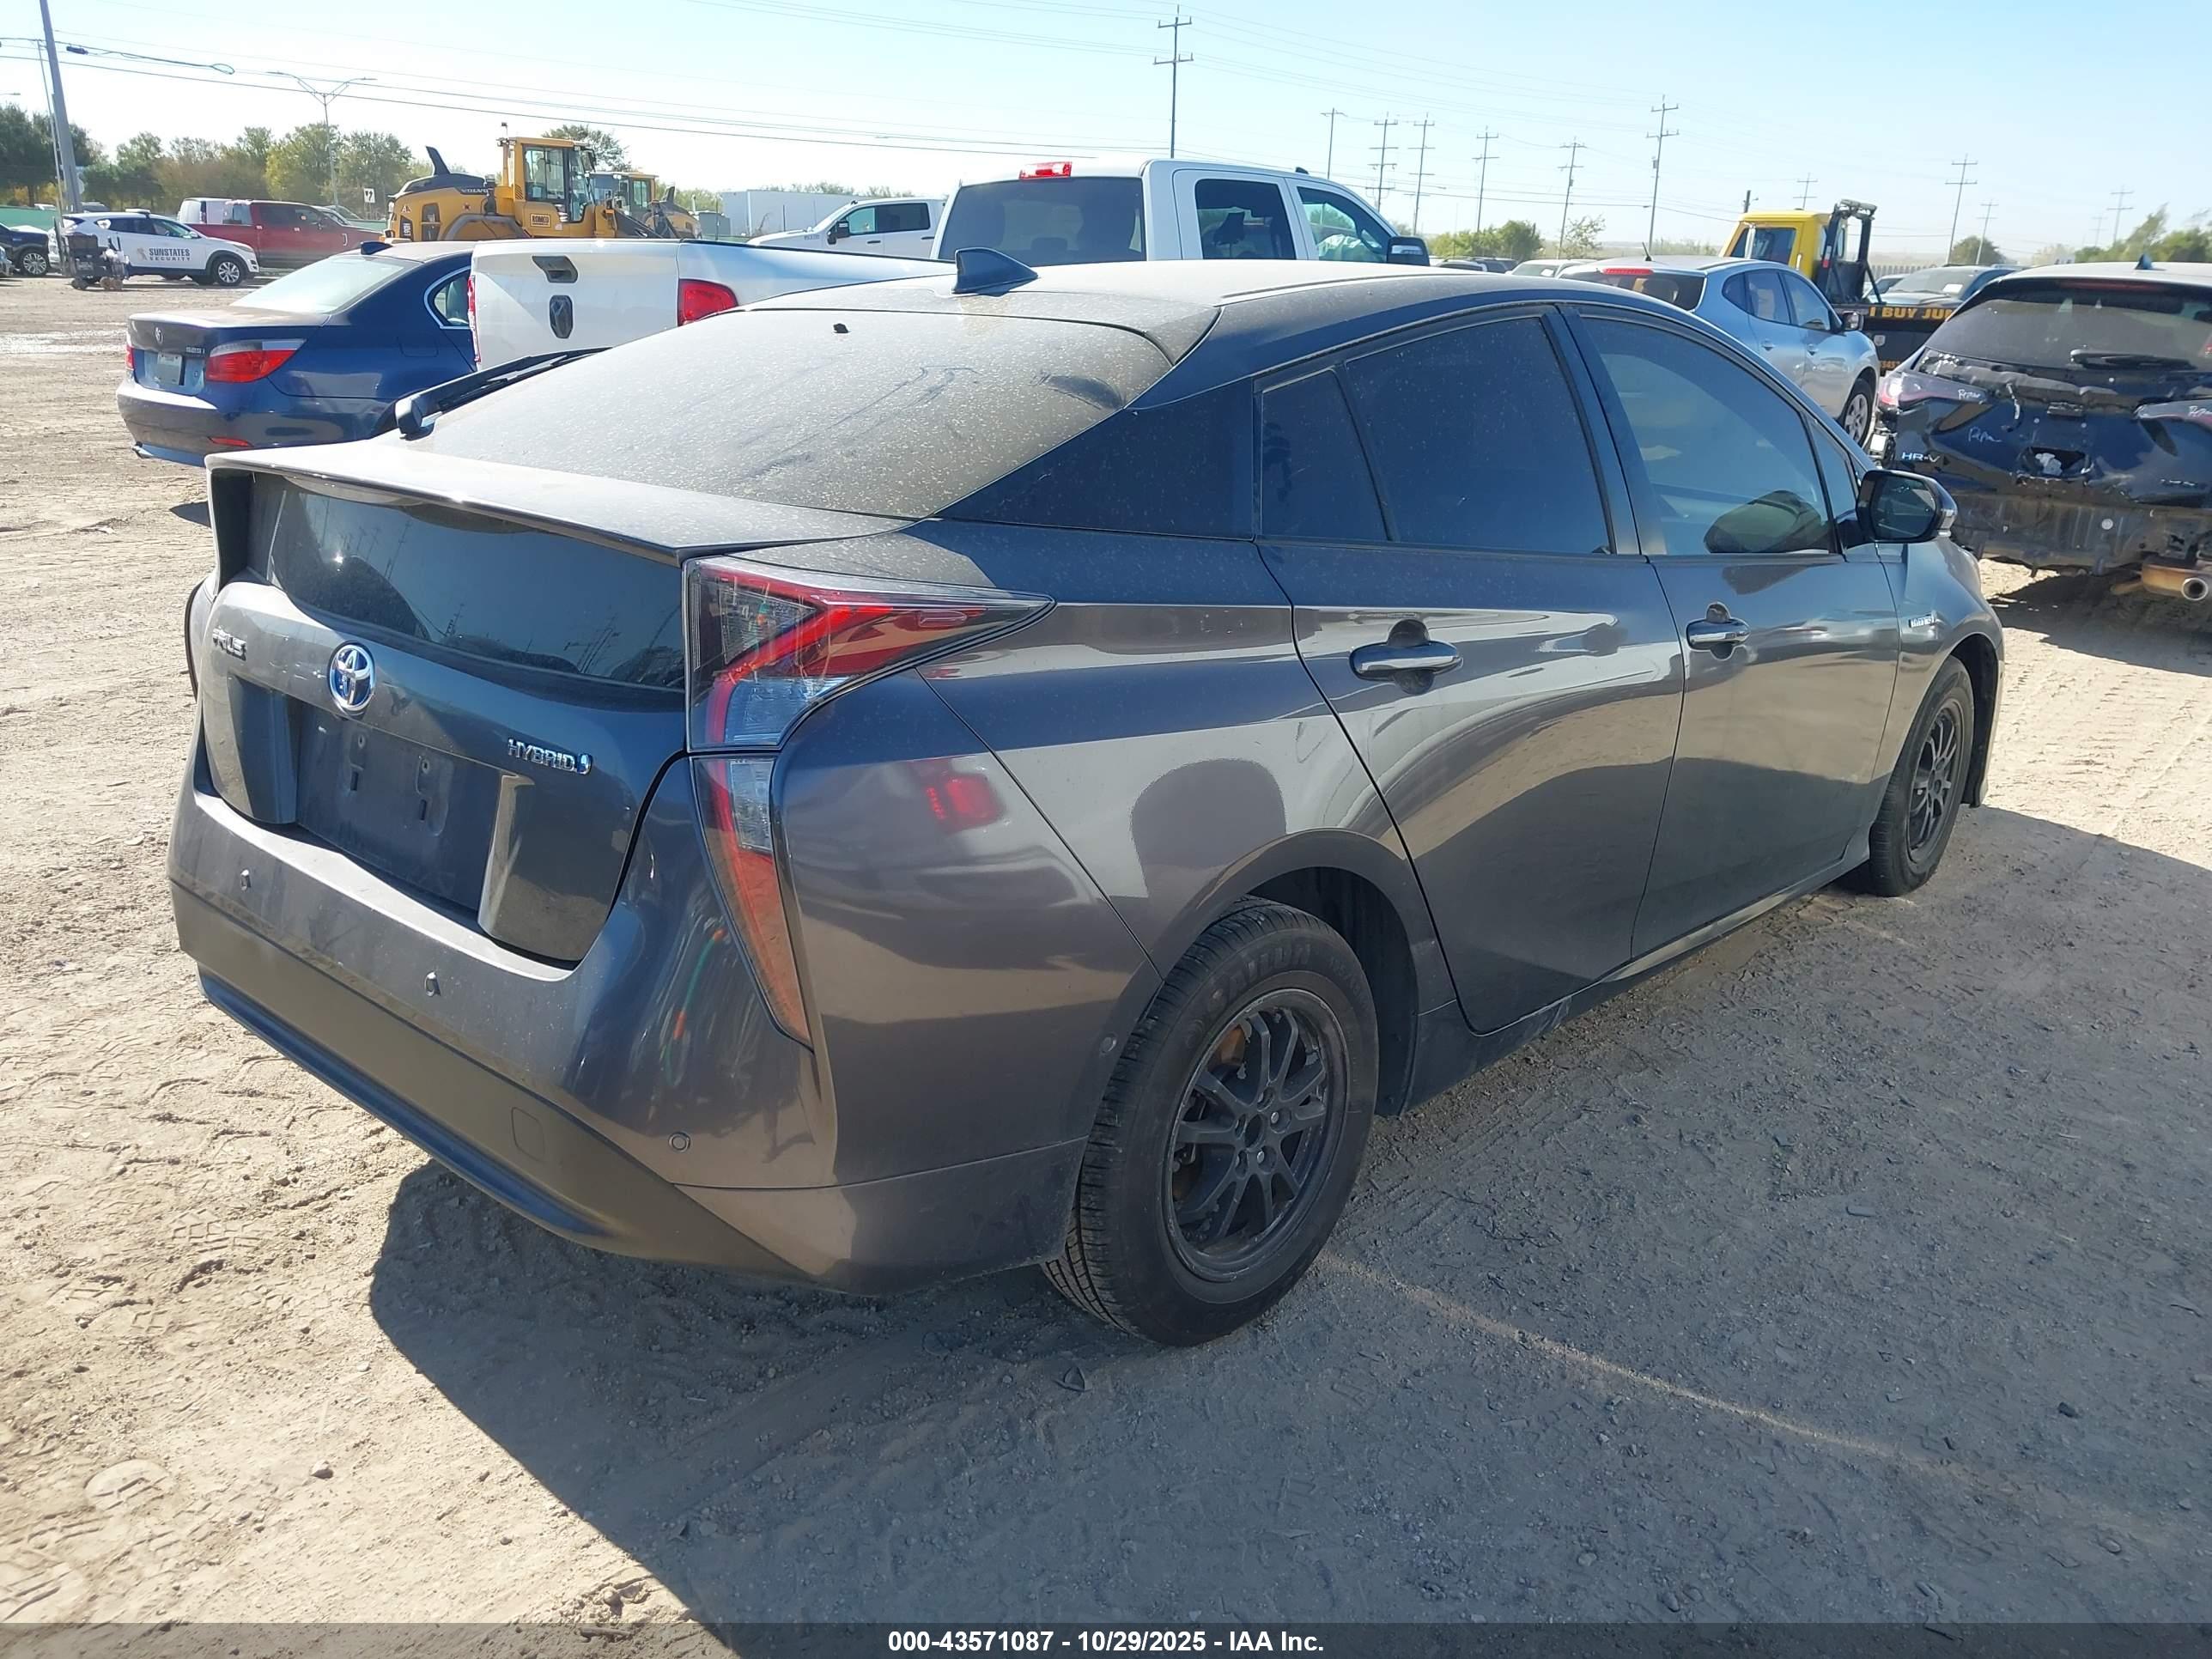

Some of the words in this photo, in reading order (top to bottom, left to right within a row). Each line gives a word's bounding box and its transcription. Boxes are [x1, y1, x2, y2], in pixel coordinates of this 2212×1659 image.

[149, 247, 191, 257] SUNSTATES
[1869, 307, 1876, 317] I
[1881, 307, 1917, 319] BUY
[1901, 452, 1941, 463] HR-V
[507, 738, 576, 772] HYBRID
